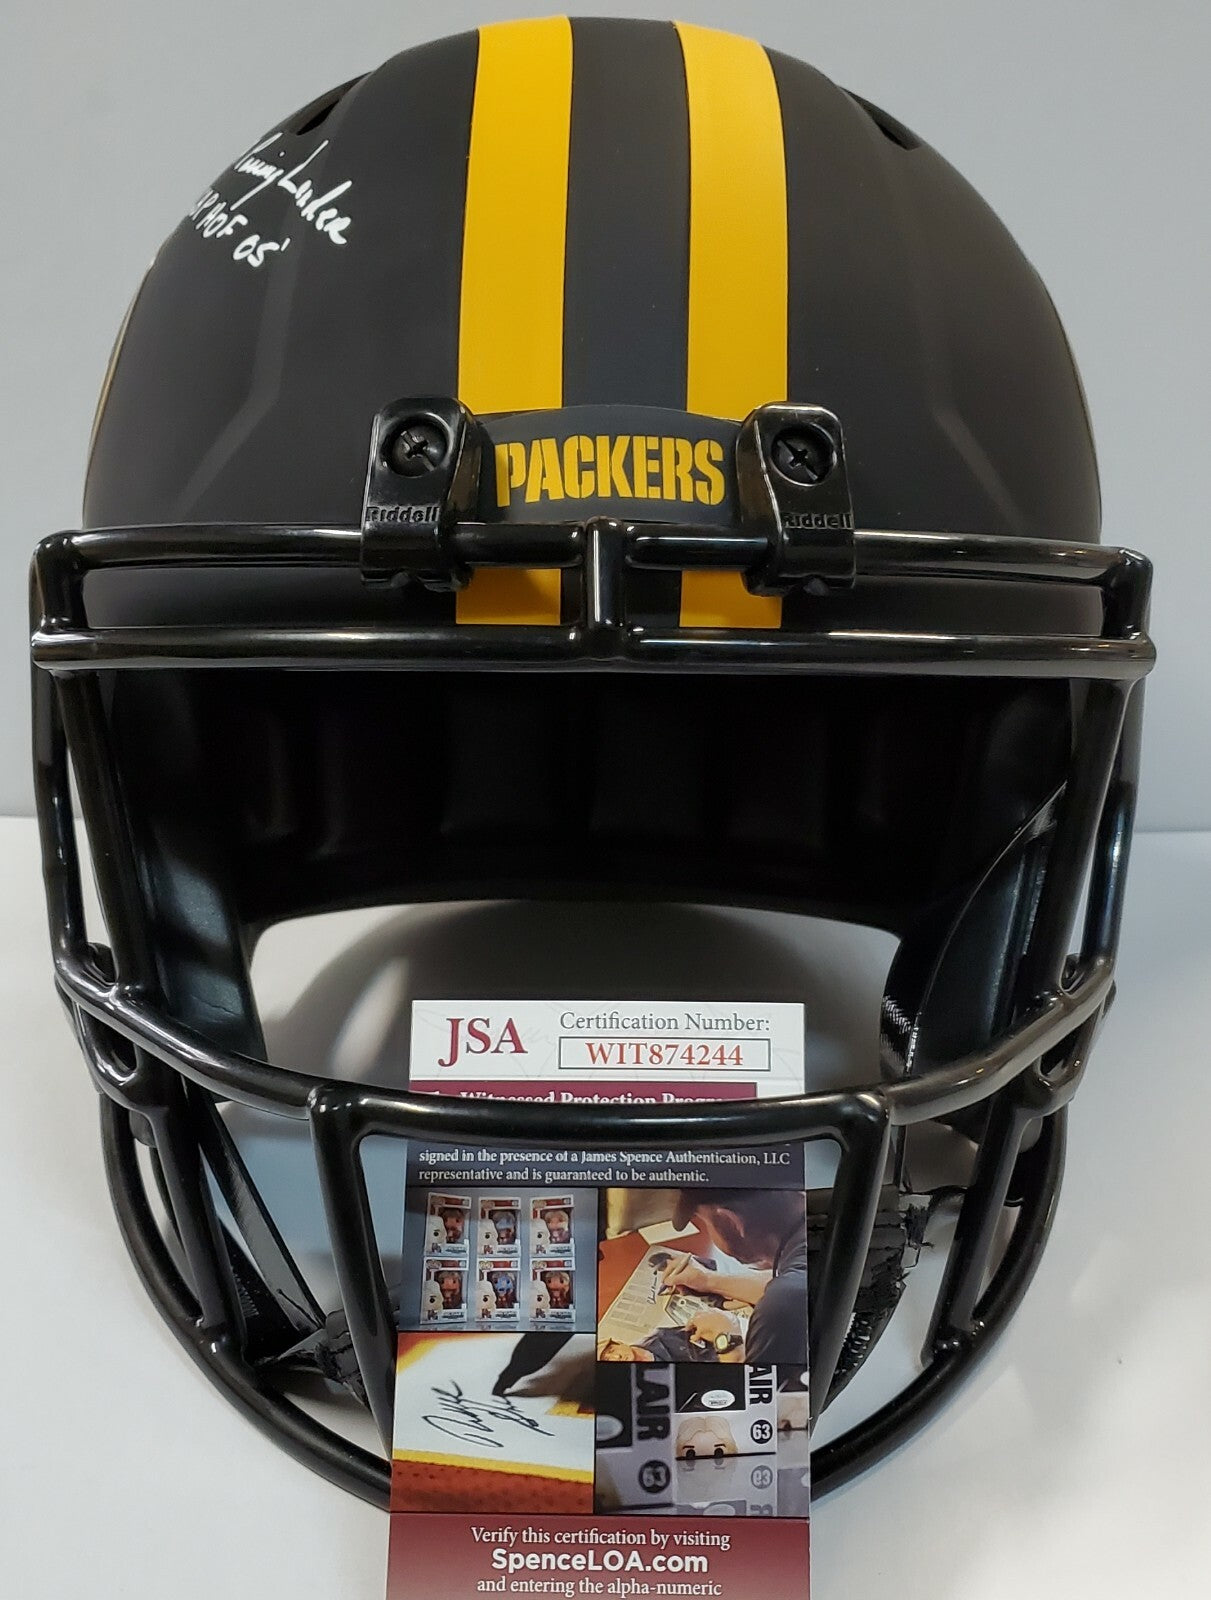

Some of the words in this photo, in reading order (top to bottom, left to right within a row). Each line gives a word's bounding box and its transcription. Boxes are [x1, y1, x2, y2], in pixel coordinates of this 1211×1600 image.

[495, 434, 725, 508] PACKERS
[365, 506, 440, 522] Riddell
[560, 1011, 679, 1030] Certification
[684, 1013, 770, 1032] Number:
[438, 1017, 528, 1067] JSA
[585, 1042, 743, 1066] WIT874244
[419, 1149, 459, 1165] signed
[462, 1150, 475, 1162] in
[477, 1149, 497, 1162] the
[499, 1152, 552, 1165] presence
[555, 1151, 569, 1162] of
[571, 1154, 578, 1162] a
[580, 1151, 617, 1164] James
[619, 1151, 663, 1166] Spence
[665, 1151, 761, 1166] Authentication,
[763, 1152, 791, 1165] LLC
[419, 1168, 503, 1183] representative
[505, 1168, 529, 1180] and
[532, 1168, 542, 1180] is
[545, 1168, 613, 1184] guaranteed
[615, 1170, 628, 1181] to
[631, 1169, 646, 1182] be
[649, 1170, 709, 1182] authentic.
[752, 1423, 771, 1441] 63
[471, 1526, 518, 1547] Verify
[522, 1527, 550, 1543] this
[554, 1528, 647, 1545] certification
[650, 1529, 670, 1550] by
[673, 1530, 731, 1551] visiting
[491, 1548, 708, 1573] SpenceLOA.com
[477, 1575, 506, 1592] and
[510, 1578, 575, 1598] entering
[579, 1577, 604, 1594] the
[607, 1577, 722, 1599] alpha-numeric
